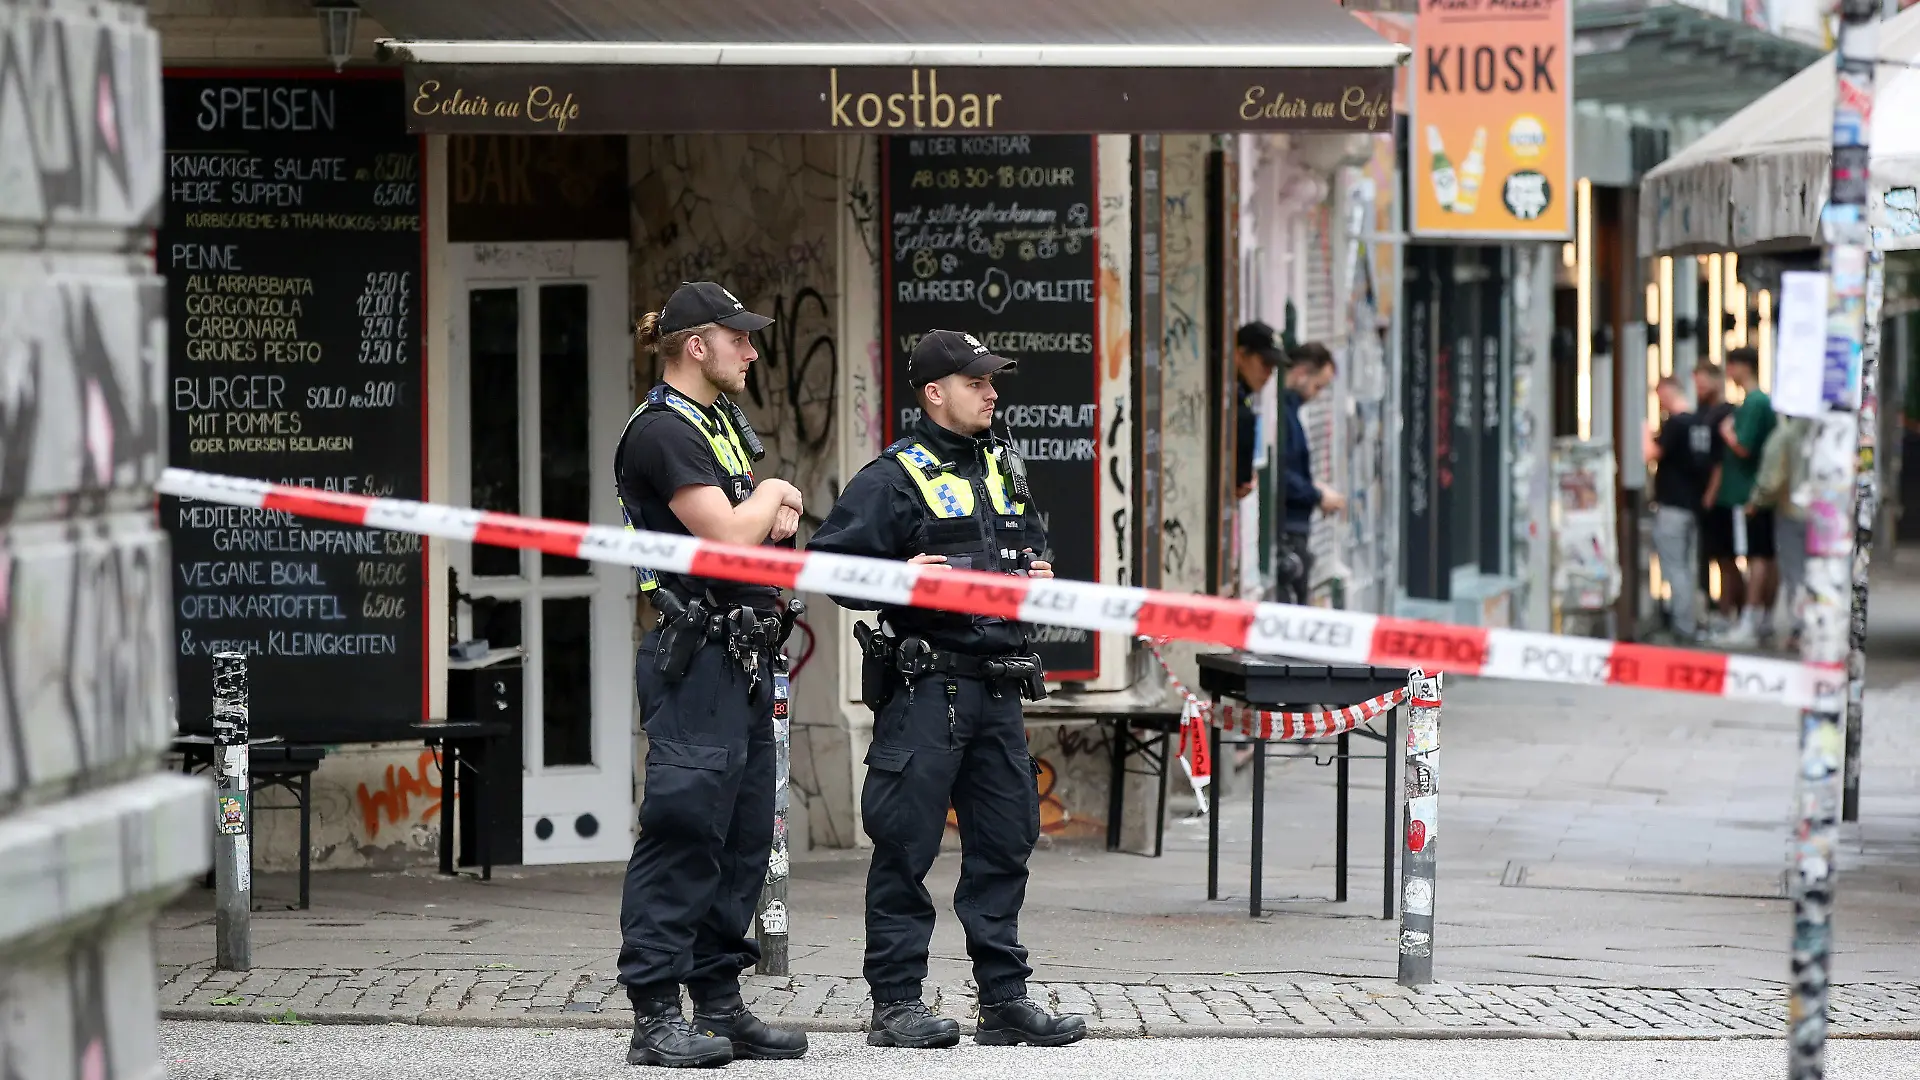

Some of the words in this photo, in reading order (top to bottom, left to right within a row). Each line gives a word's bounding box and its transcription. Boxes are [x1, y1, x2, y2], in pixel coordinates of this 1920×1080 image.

[1426, 44, 1556, 93] KIOSK
[197, 87, 335, 131] SPEISEN
[413, 79, 489, 116] Eclair
[494, 100, 521, 118] au
[526, 84, 580, 133] Cafe
[830, 67, 1002, 128] kostbar
[1239, 85, 1307, 121] Eclair
[1311, 101, 1336, 118] au
[1340, 85, 1390, 130] Cafe
[928, 137, 957, 155] DER
[961, 135, 1032, 155] KOSTBAR
[170, 155, 263, 179] KNACKIGE
[274, 157, 347, 181] SALATE
[231, 184, 302, 206] SUPPEN
[172, 243, 242, 271] PENNE
[898, 279, 976, 302] RÜHREIER
[1012, 279, 1095, 302] OMELETTE
[185, 293, 303, 317] GORGONZOLA
[185, 316, 298, 340] CARBONARA
[186, 339, 257, 362] GRÜNES
[263, 340, 322, 364] PESTO
[978, 331, 1093, 354] VEGETARISCHES
[174, 375, 286, 411] BURGER
[306, 386, 347, 409] SOLO
[188, 412, 220, 435] MIT
[226, 411, 301, 435] POMMES
[1004, 404, 1098, 428] OBSTSALAT
[190, 438, 225, 453] ODER
[228, 437, 286, 452] DIVERSEN
[289, 436, 353, 452] BEILAGEN
[213, 528, 382, 555] GARNELENPFANNE
[180, 561, 266, 588] VEGANE
[270, 560, 326, 586] BOWL
[180, 593, 347, 619] OFENKARTOFFEL
[181, 628, 195, 656] &
[267, 630, 397, 656] KLEINIGKEITEN
[1239, 611, 1355, 649] POLIZEI
